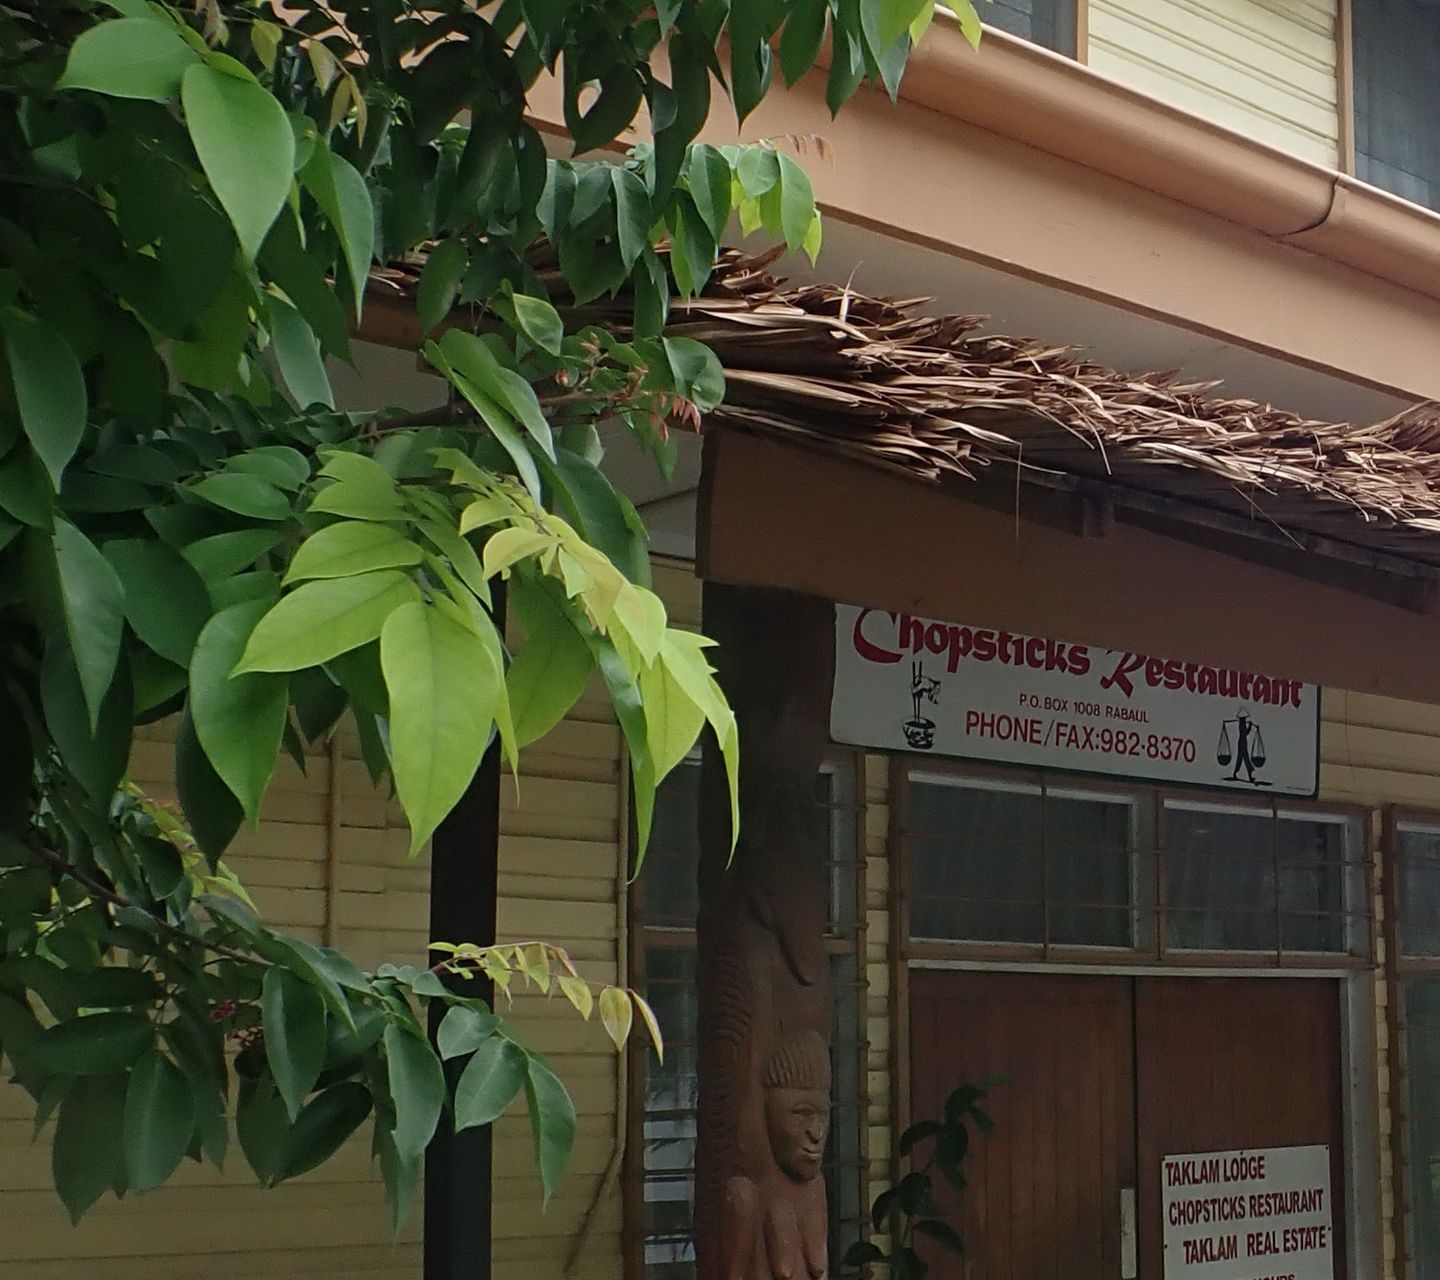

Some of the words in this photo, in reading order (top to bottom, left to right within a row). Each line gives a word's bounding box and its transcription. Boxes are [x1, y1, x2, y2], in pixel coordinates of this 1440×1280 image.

[853, 607, 1091, 675] Chopsticks
[1100, 650, 1303, 709] Restaurant
[1044, 696, 1068, 713] BOX
[1073, 701, 1100, 717] 1008
[1105, 705, 1149, 724] RABAUL
[1165, 1159, 1219, 1187] TAKLAM
[1223, 1156, 1265, 1182] LODGE
[1169, 1195, 1245, 1226] CHOPSTICKS
[1249, 1189, 1323, 1218] RESTAURANT
[1183, 1235, 1238, 1265] TAKLAM
[1247, 1231, 1279, 1257] REAL
[1283, 1226, 1326, 1252] ESTATE
